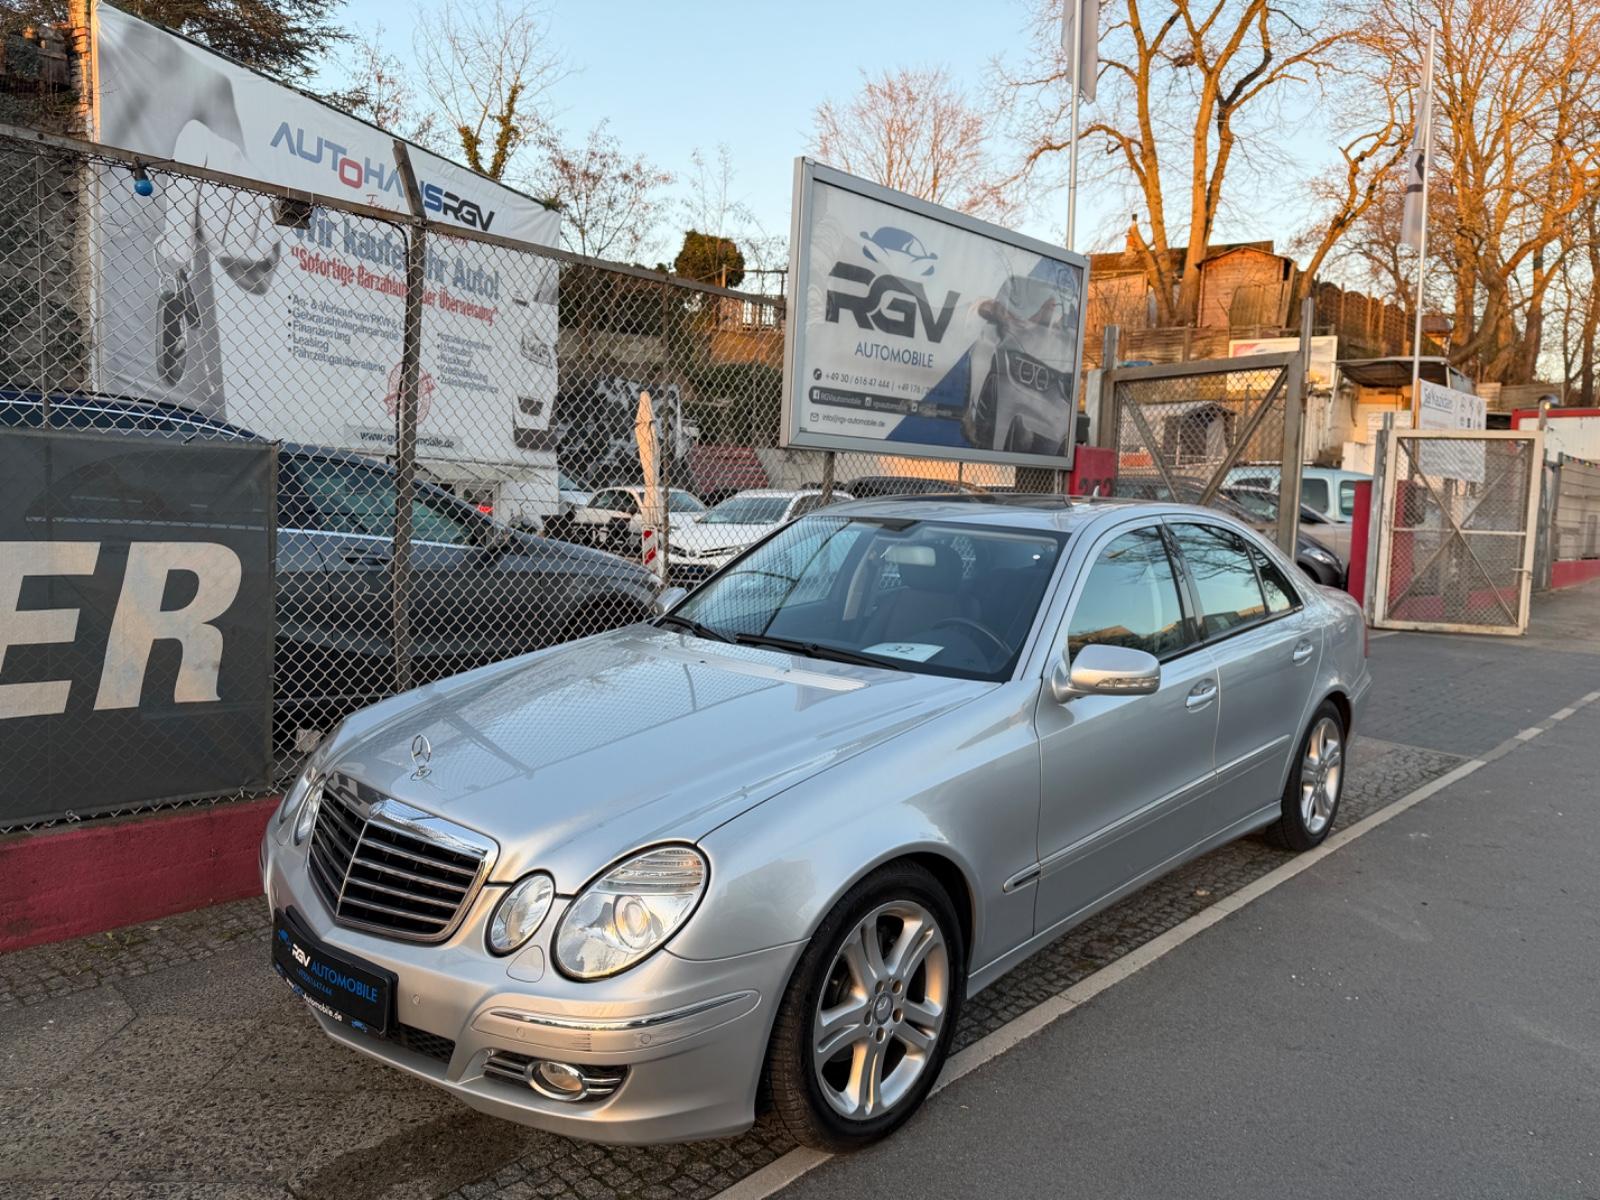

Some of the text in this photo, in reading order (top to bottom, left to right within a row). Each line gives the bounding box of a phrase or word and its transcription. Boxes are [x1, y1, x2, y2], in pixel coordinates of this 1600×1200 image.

[344, 217, 408, 272] kaufe
[453, 257, 499, 300] Auto!
[357, 260, 410, 298] Barzahlun
[825, 261, 961, 343] RGV
[854, 341, 934, 369] AUTOMOBILE
[292, 943, 311, 967] RGV
[311, 960, 378, 1003] AUTOMOBILE
